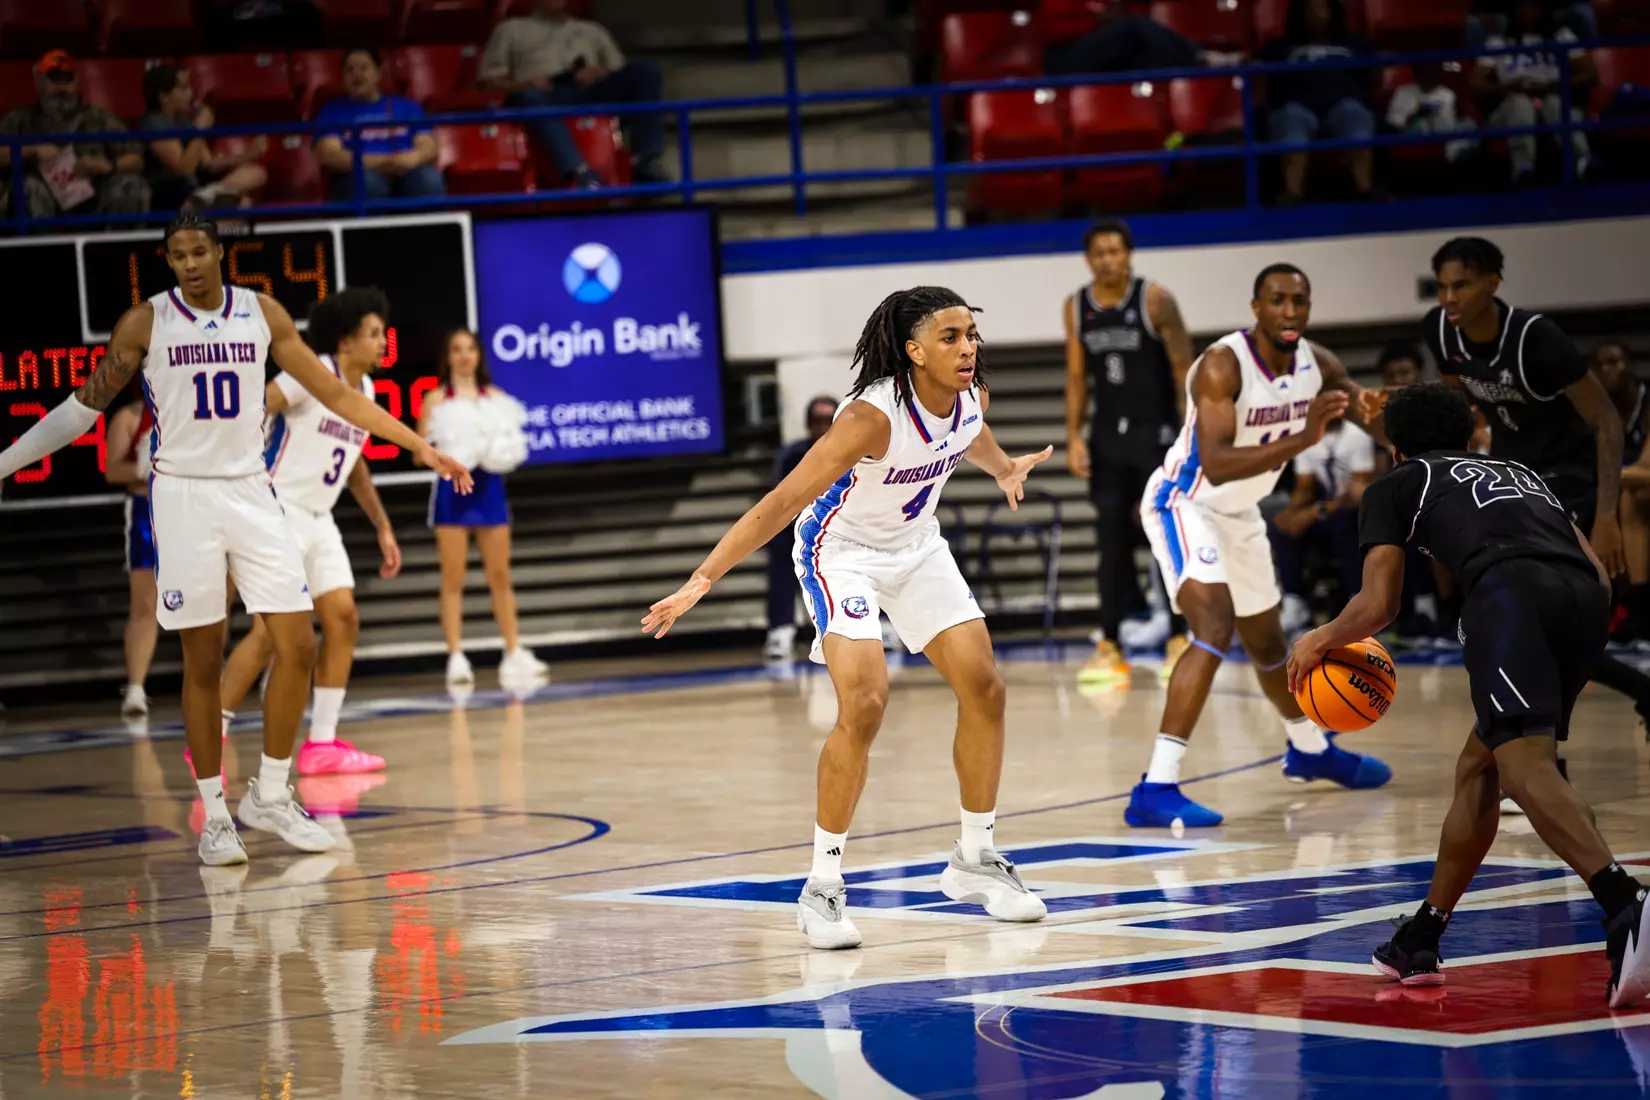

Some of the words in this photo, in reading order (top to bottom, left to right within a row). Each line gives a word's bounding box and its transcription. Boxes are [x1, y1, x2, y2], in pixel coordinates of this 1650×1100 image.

[168, 343, 229, 367] LOUISIANA
[229, 342, 256, 363] TECH
[492, 320, 605, 367] Origin
[613, 312, 702, 354] Bank
[192, 370, 241, 420] 10
[323, 446, 346, 486] 3
[882, 457, 946, 485] LOUISIANA
[901, 482, 936, 522] 4
[1450, 461, 1566, 513] 24
